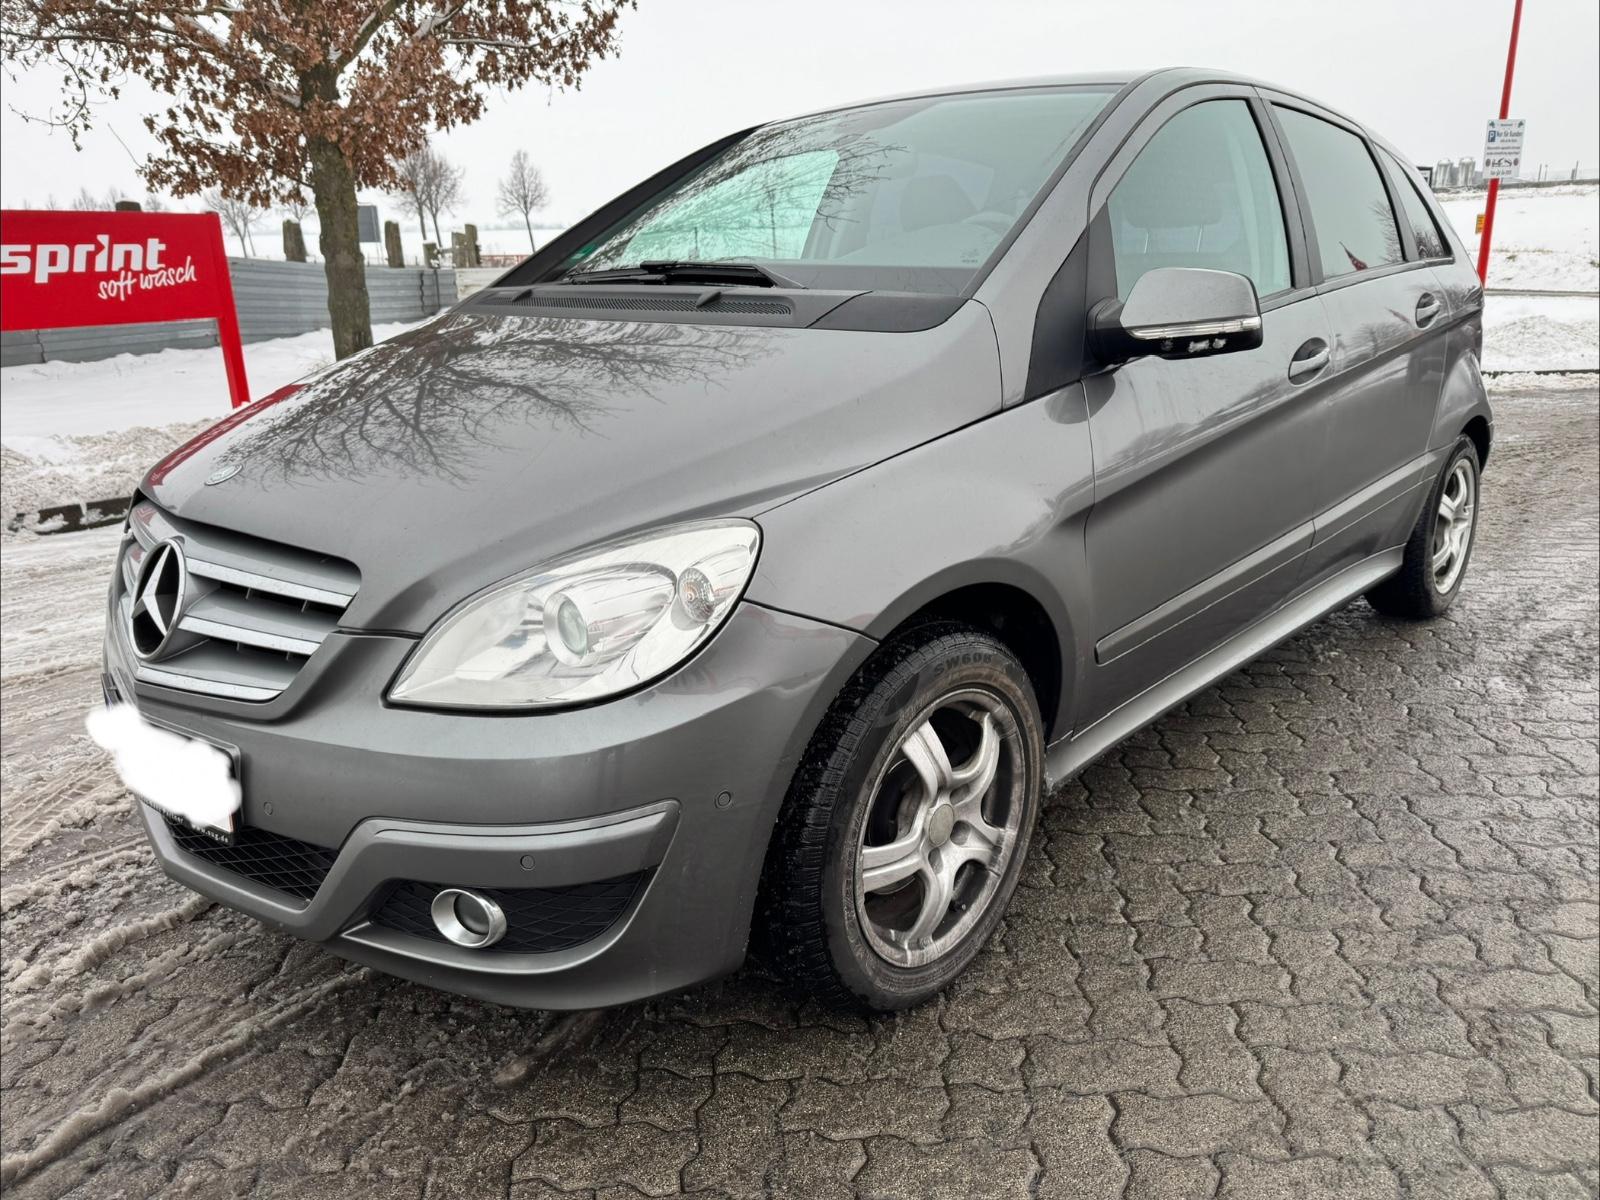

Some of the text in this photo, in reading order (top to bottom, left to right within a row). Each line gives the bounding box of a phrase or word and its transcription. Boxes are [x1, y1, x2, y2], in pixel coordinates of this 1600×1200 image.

[1, 234, 166, 284] sprint
[98, 255, 197, 301] soft wasch
[934, 652, 992, 677] SW608
